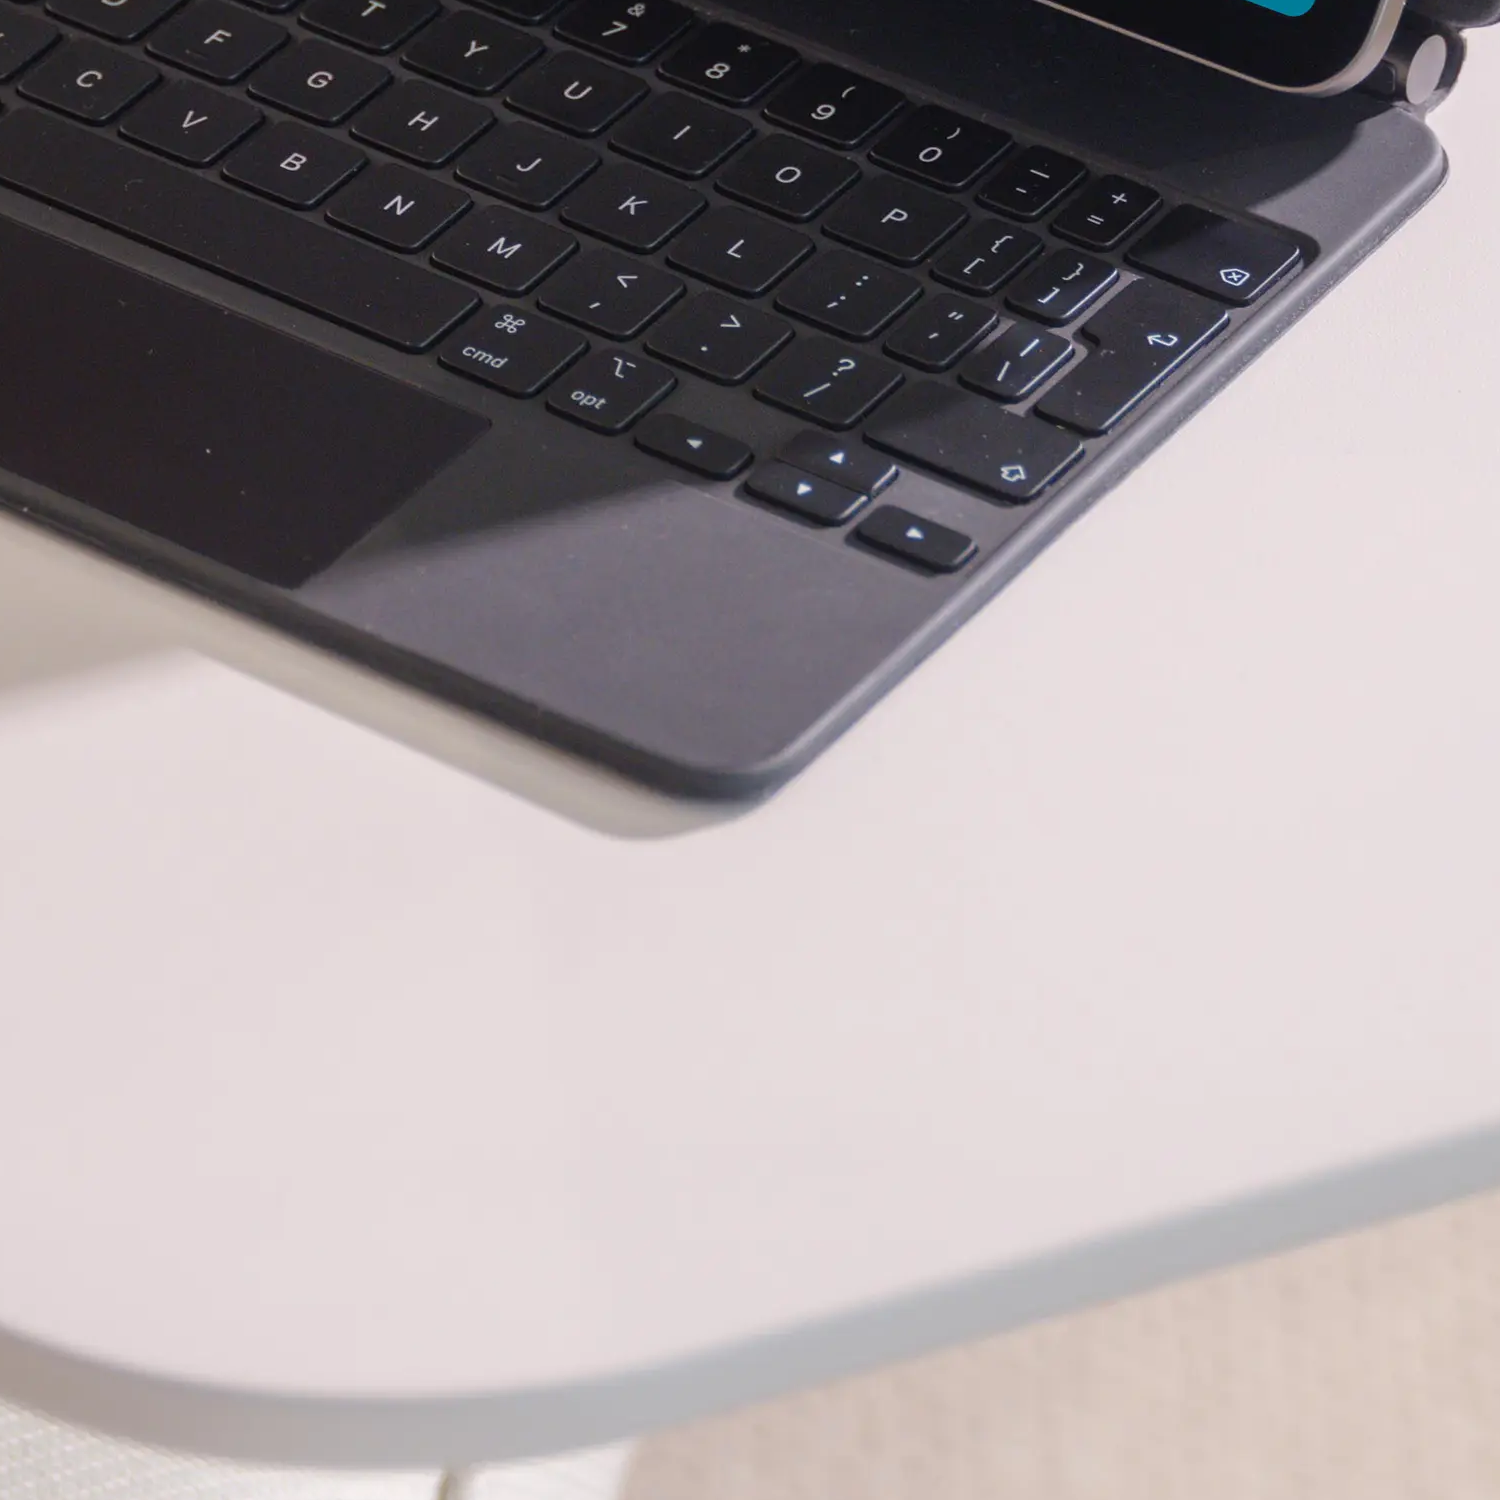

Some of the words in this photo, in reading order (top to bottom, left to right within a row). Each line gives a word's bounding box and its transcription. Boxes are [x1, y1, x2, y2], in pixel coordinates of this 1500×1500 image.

[75, 69, 104, 89] C
[181, 109, 209, 129] V
[278, 151, 308, 172] B
[382, 194, 416, 217] N
[486, 235, 523, 260] M
[202, 28, 233, 45] F
[305, 70, 334, 90] G
[406, 110, 440, 133] H
[514, 156, 543, 173] J
[617, 194, 649, 217] K
[725, 238, 746, 260] L
[462, 39, 490, 59] Y
[562, 80, 594, 101] U
[672, 124, 692, 141] I
[774, 165, 803, 185] O
[880, 207, 910, 224] P
[600, 20, 629, 38] 7
[703, 61, 732, 80] 8
[809, 103, 837, 122] 9
[917, 145, 944, 164] 0
[626, 2, 647, 19] &
[1110, 192, 1129, 205] +
[461, 345, 510, 370] cmd
[569, 389, 608, 411] opt
[831, 357, 857, 378] ?
